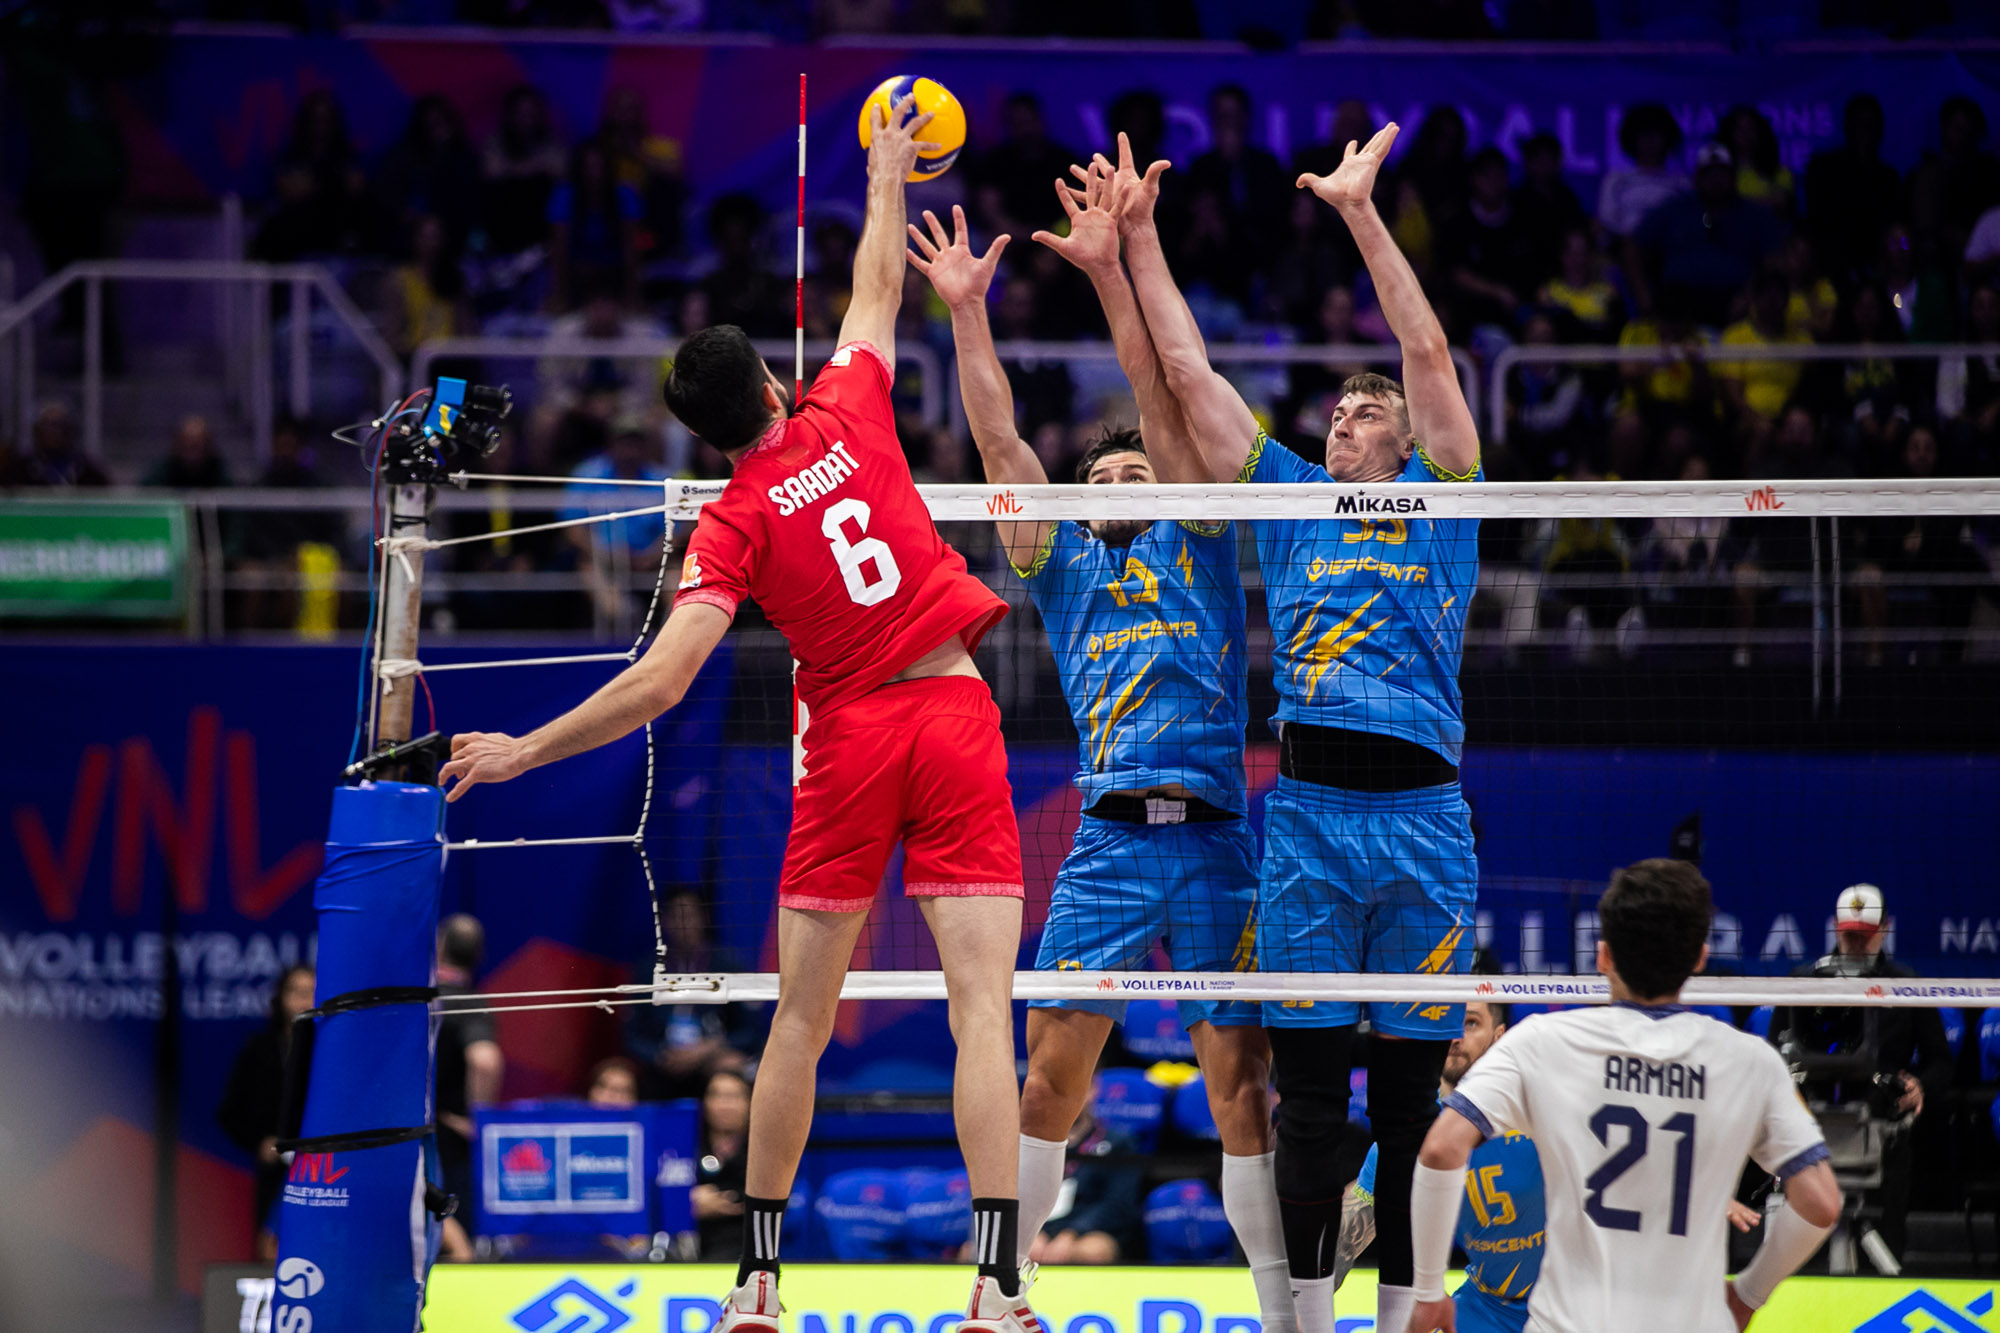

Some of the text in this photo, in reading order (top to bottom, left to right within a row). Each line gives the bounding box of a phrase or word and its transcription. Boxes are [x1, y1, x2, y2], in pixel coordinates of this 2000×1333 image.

[768, 440, 860, 516] SAADAT
[986, 489, 1023, 516] VNL
[1334, 489, 1427, 514] MIKASA
[1744, 485, 1785, 512] VNL
[821, 497, 902, 607] 6
[11, 704, 325, 922] VNL
[182, 980, 272, 1020] LEA
[1121, 980, 1207, 990] VOLLEYBALL
[1502, 984, 1590, 995] VOLLEYBALL
[1604, 1055, 1706, 1101] ARMAN
[1583, 1103, 1696, 1237] 21
[284, 1184, 350, 1199] OLLEYBALL
[1465, 1164, 1517, 1228] 15
[1470, 1230, 1549, 1254] EPICENT
